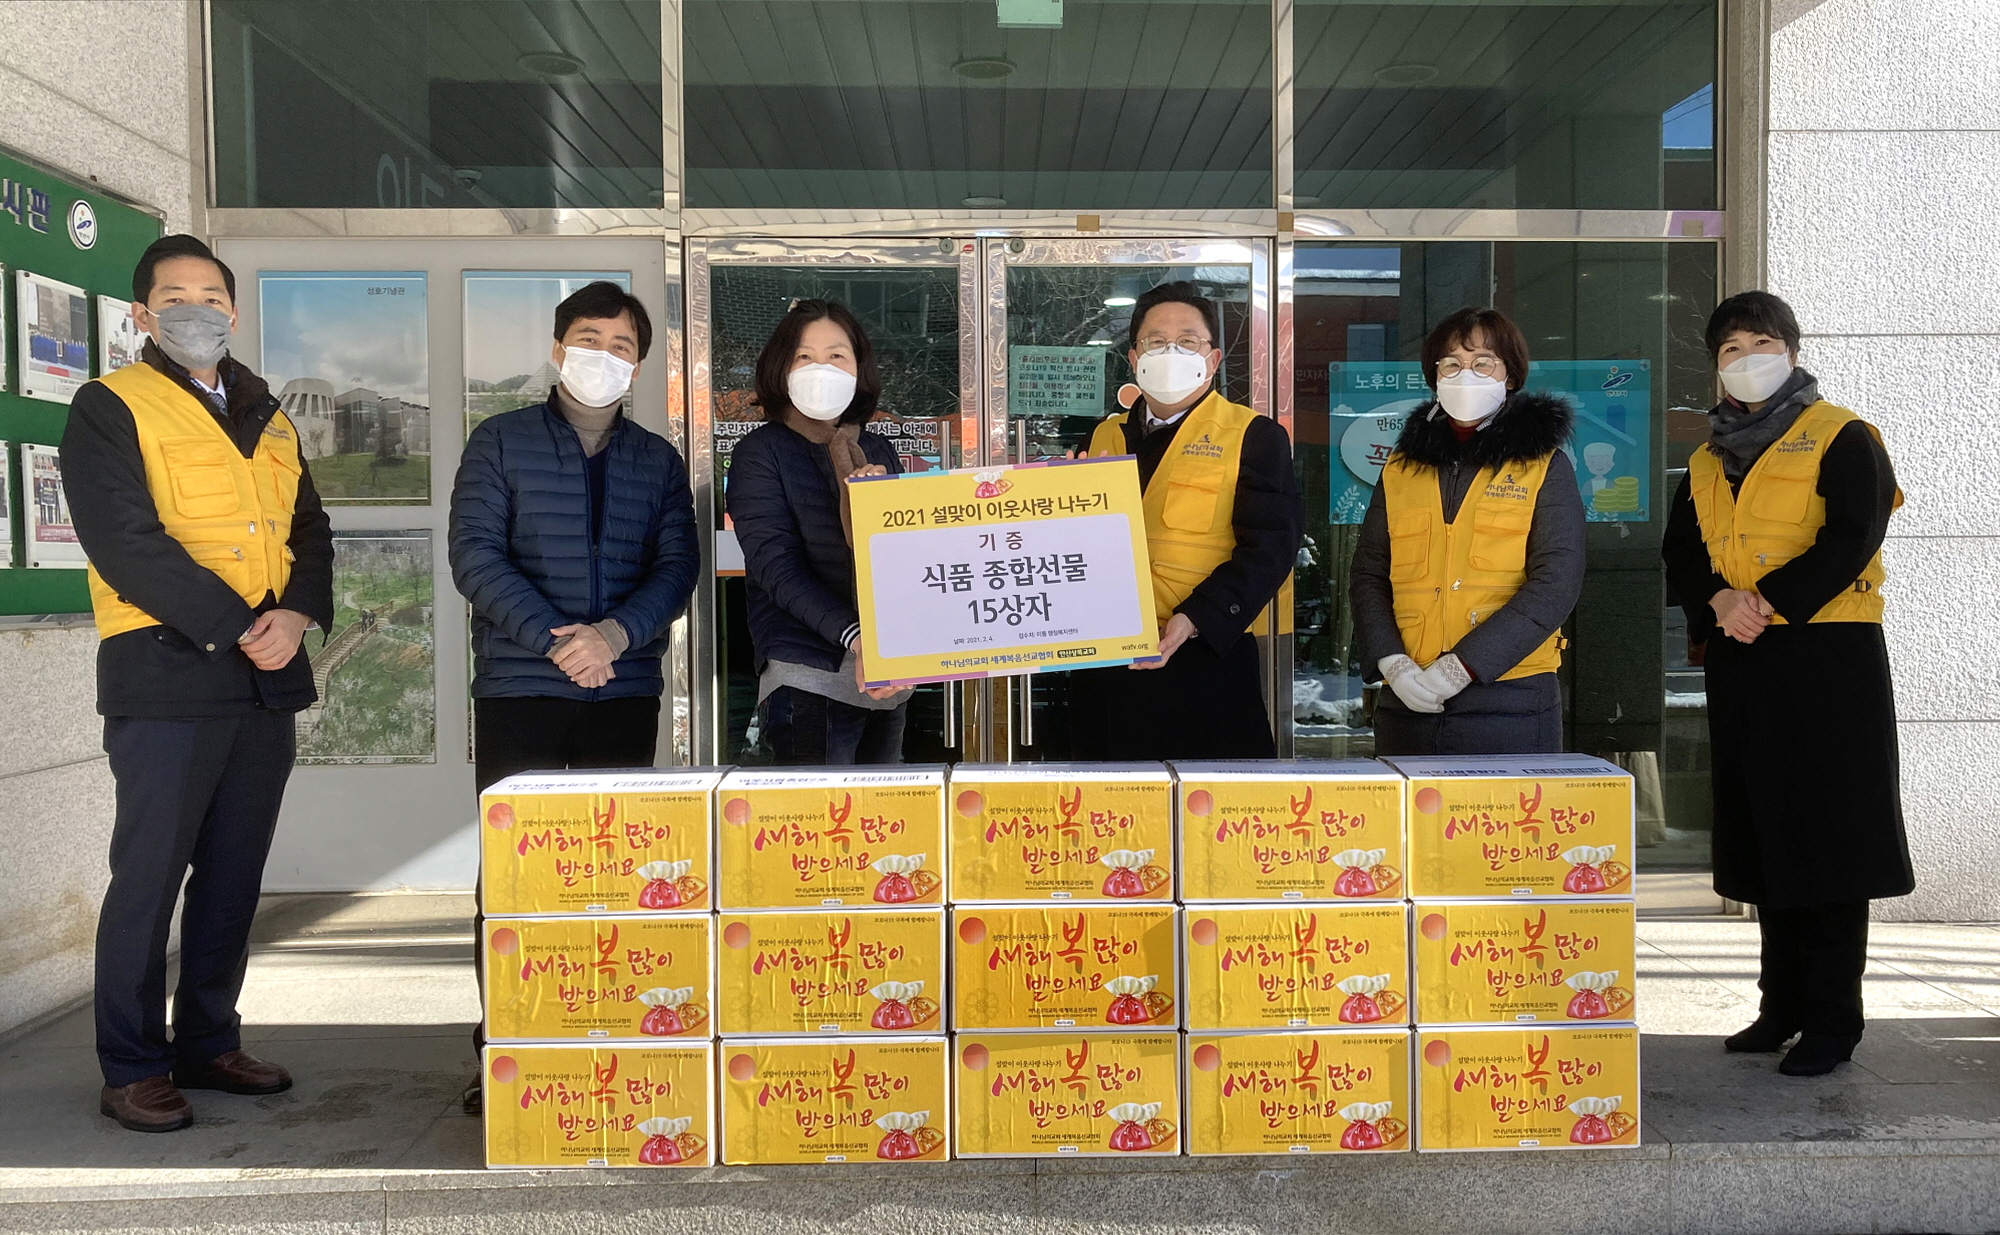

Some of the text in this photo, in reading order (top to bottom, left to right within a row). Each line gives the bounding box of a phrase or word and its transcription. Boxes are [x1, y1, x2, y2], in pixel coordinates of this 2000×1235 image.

[367, 286, 406, 296] 성호기념관
[1019, 364, 1046, 372] 코로나19
[1050, 364, 1063, 372] 확산
[1083, 365, 1096, 373] 관련
[1355, 374, 1398, 390] 노후의
[1044, 382, 1070, 390] 이용하여
[903, 422, 937, 436] 아래에
[1376, 417, 1404, 431] 만65
[883, 492, 1109, 528] 2021 설맞이 이웃사랑 나누기
[979, 530, 1024, 552] 기 증
[921, 554, 1088, 594] 식품 종합선물
[968, 592, 1052, 626] 15상자
[941, 656, 988, 668] 하나님의교회
[991, 651, 1054, 664] 세계복음선교협회
[1121, 643, 1149, 651] watv.org
[806, 813, 824, 821] 나누기
[984, 786, 1134, 847] 새해 복 많이
[1215, 785, 1366, 847] 새해 복 많이
[1220, 806, 1239, 814] 설맞이
[1267, 806, 1285, 814] 나누기
[1443, 782, 1595, 844] 새해 복 많이
[1496, 803, 1515, 811] 나누기
[516, 797, 671, 859] 새해 복 많이
[753, 792, 905, 854] 새해 복 많이
[792, 852, 871, 881] 받으세요
[1022, 845, 1100, 875] 받으세요
[1253, 845, 1331, 874] 받으세요
[1482, 842, 1561, 871] 받으세요
[556, 857, 636, 887] 받으세요
[805, 938, 823, 946] 나누기
[987, 912, 1138, 974] 새해 복 많이
[1220, 913, 1370, 974] 새해 복 많이
[1449, 909, 1599, 970] 새해 복 많이
[1501, 929, 1519, 937] 나누기
[519, 923, 673, 986] 새해 복 많이
[572, 944, 591, 952] 나누기
[752, 917, 904, 979] 새해 복 많이
[790, 977, 869, 1007] 받으세요
[1026, 972, 1104, 1002] 받으세요
[1258, 972, 1336, 1002] 받으세요
[1487, 968, 1565, 997] 받으세요
[558, 983, 638, 1013] 받으세요
[762, 1070, 781, 1078] 설맞이
[809, 1069, 828, 1077] 나누기
[990, 1039, 1141, 1101] 새해 복 많이
[996, 1060, 1014, 1068] 설맞이
[1043, 1060, 1061, 1068] 나누기
[1222, 1039, 1372, 1101] 새해 복 많이
[1227, 1061, 1245, 1069] 설맞이
[1274, 1060, 1292, 1068] 나누기
[1452, 1034, 1602, 1096] 새해 복 많이
[1458, 1056, 1476, 1064] 설맞이
[1504, 1055, 1523, 1063] 나누기
[519, 1053, 671, 1114] 새해 복 많이
[524, 1073, 543, 1081] 설맞이
[572, 1073, 590, 1081] 나누기
[757, 1048, 909, 1110] 새해 복 많이
[796, 1108, 875, 1138] 받으세요
[1029, 1099, 1107, 1128] 받으세요
[1260, 1099, 1338, 1128] 받으세요
[1490, 1094, 1568, 1123] 받으세요
[558, 1112, 637, 1142] 받으세요
